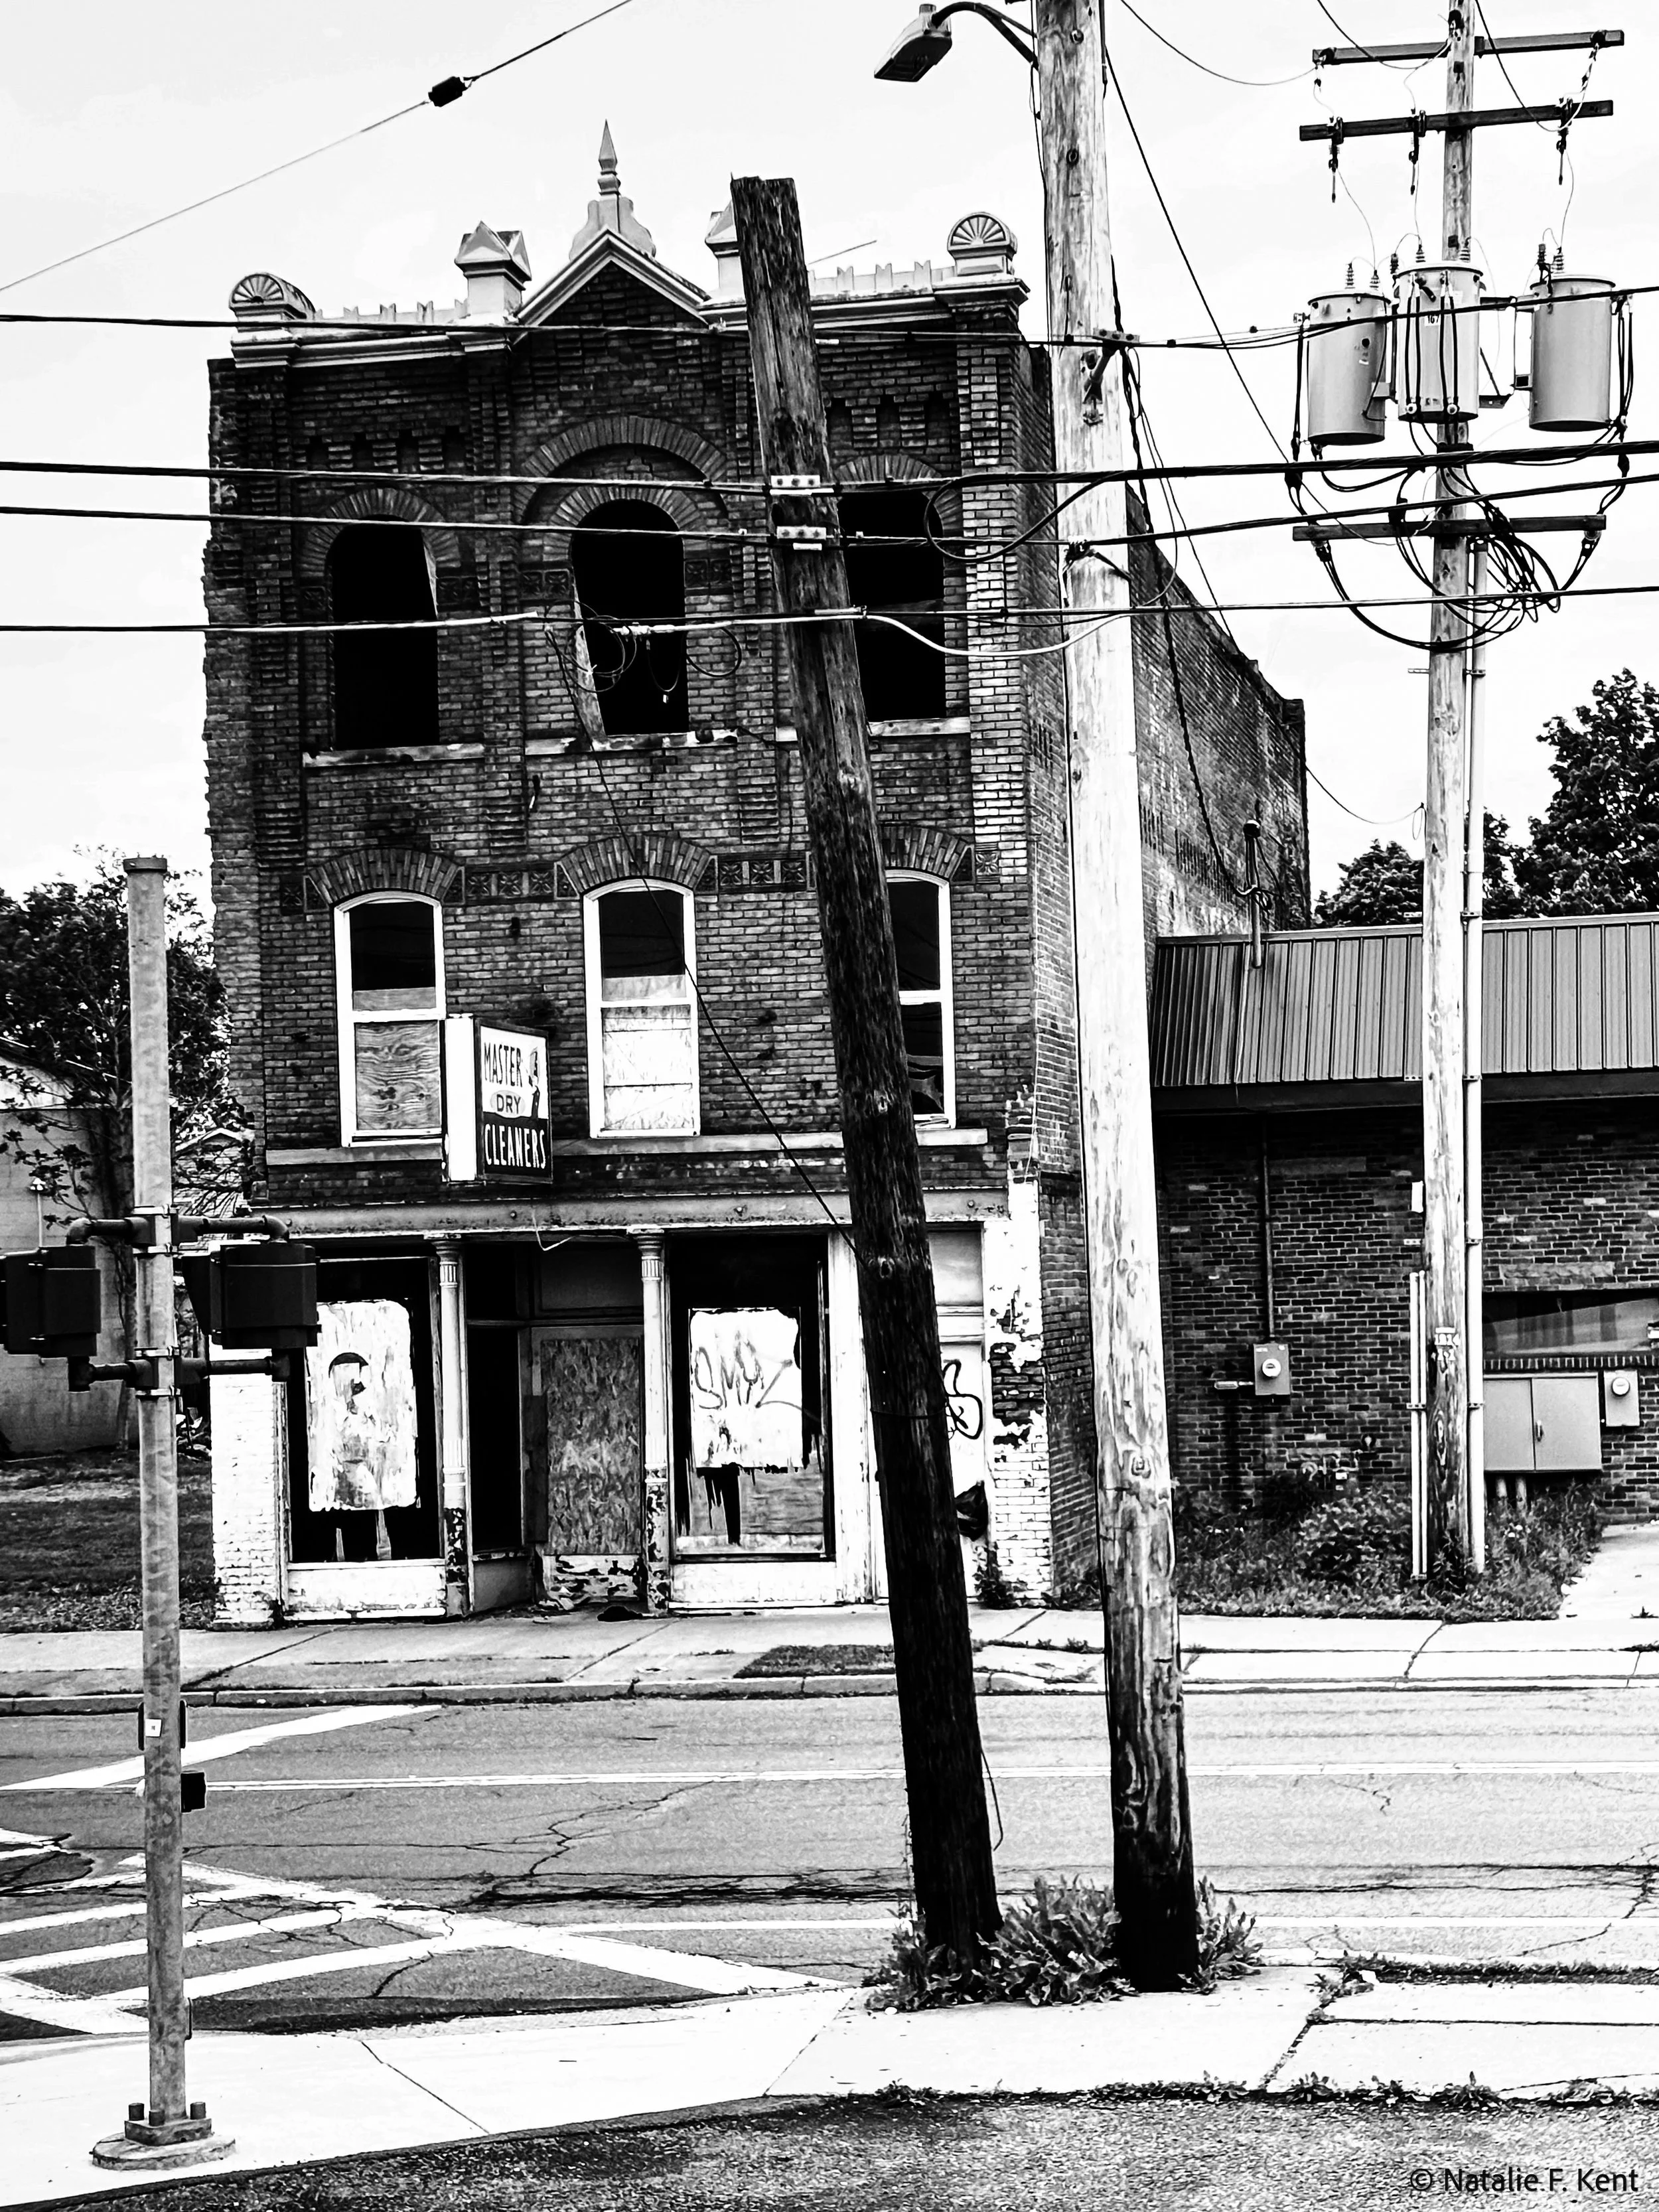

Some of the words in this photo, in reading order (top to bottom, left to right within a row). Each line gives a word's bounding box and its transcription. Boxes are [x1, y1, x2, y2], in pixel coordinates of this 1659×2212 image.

[484, 1042, 523, 1088] MASTER
[496, 1094, 522, 1114] DRY
[484, 1124, 546, 1169] CLEANERS
